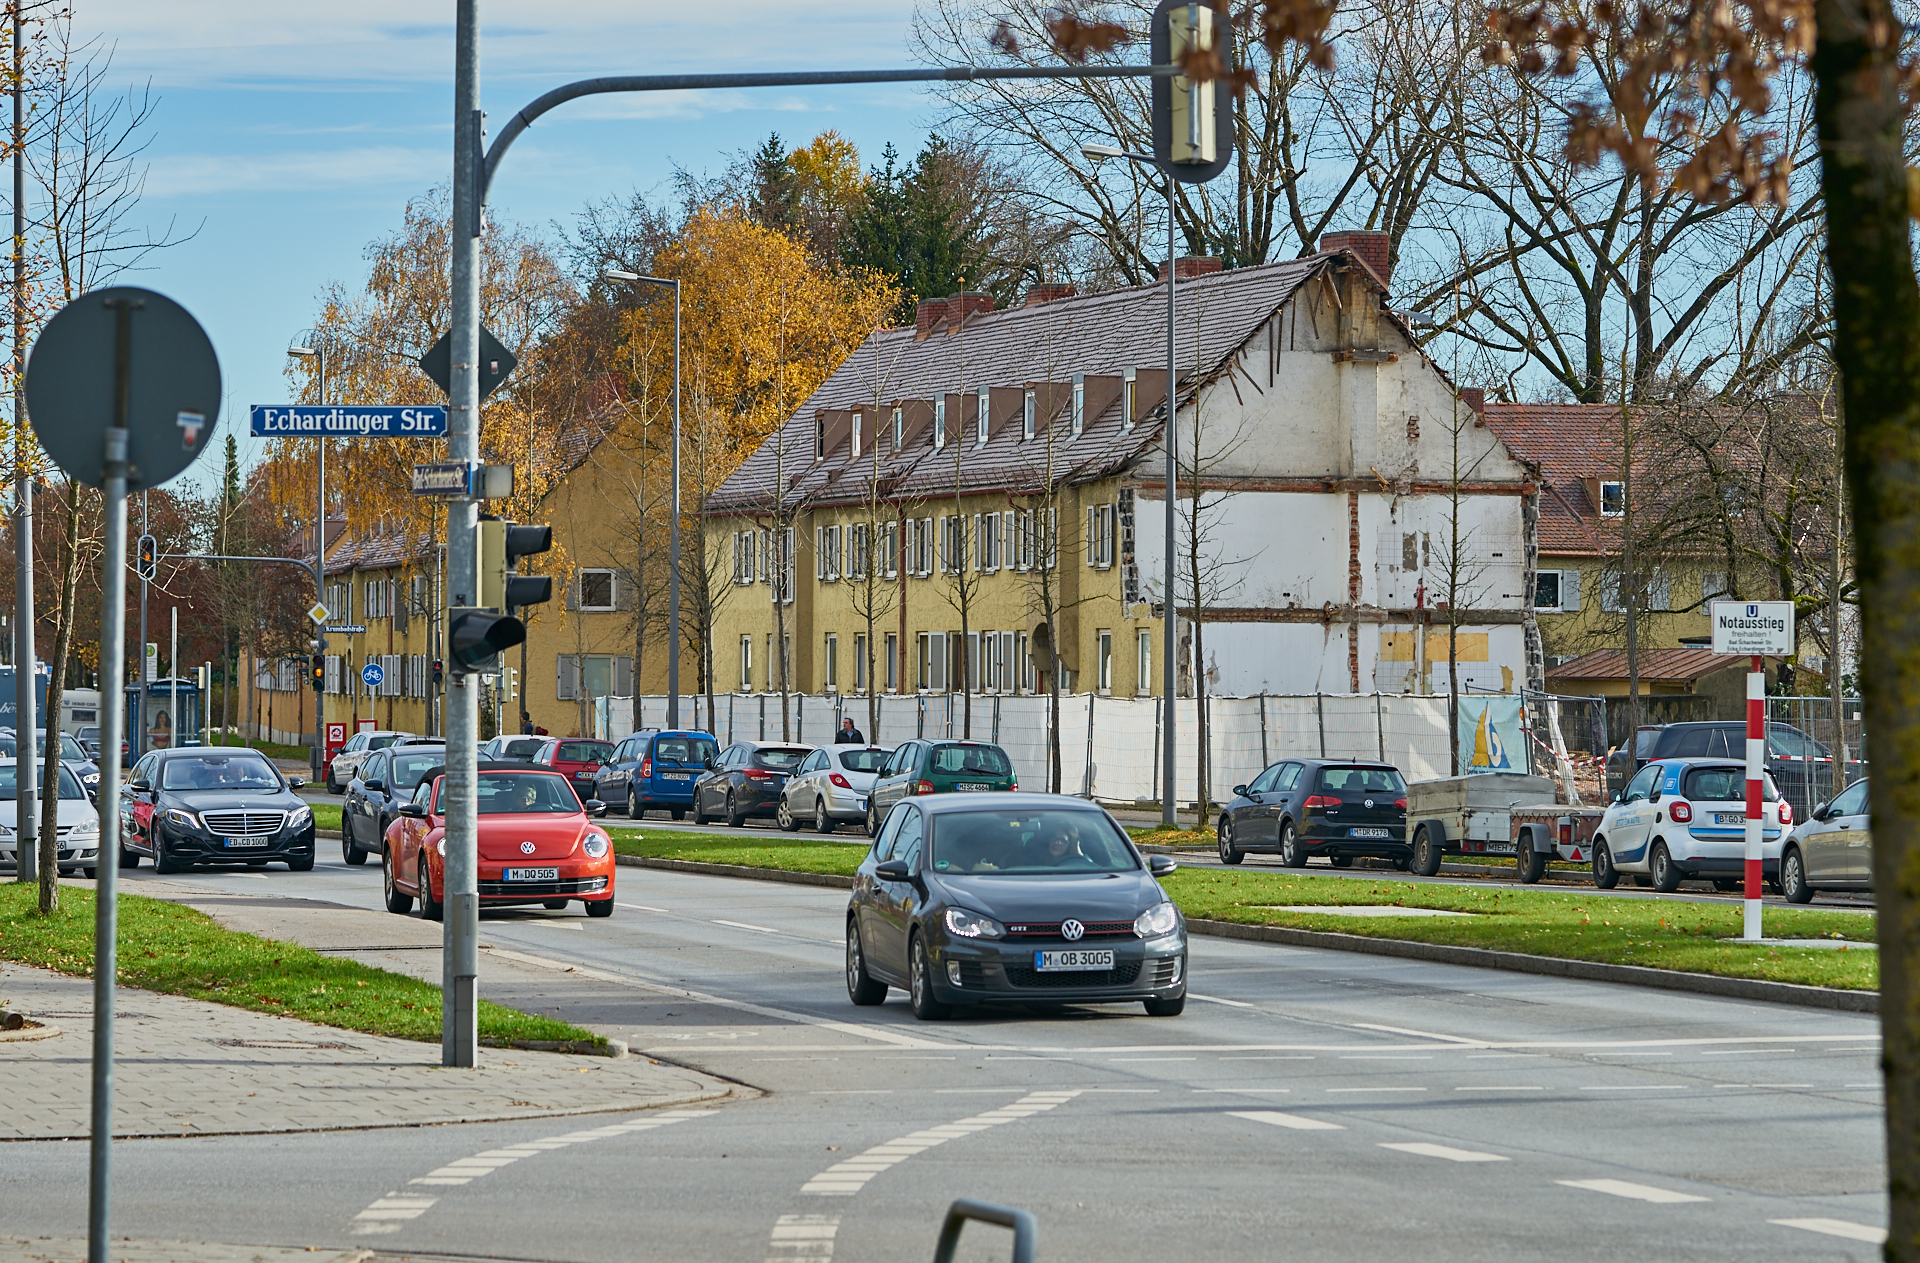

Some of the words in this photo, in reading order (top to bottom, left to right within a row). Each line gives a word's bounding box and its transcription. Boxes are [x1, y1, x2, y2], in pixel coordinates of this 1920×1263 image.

[263, 408, 393, 435] Echardinger
[401, 408, 437, 431] Str.
[1719, 616, 1784, 632] Notausstieg
[325, 625, 365, 633] Krumbadstraße
[1731, 630, 1767, 638] freihalten
[1719, 815, 1725, 823] B
[1728, 815, 1738, 824] GO
[1362, 828, 1371, 836] DR
[241, 838, 251, 846] CD
[1488, 843, 1495, 851] M
[512, 869, 519, 879] M
[524, 869, 537, 879] DQ
[538, 869, 555, 879] 505
[1043, 953, 1053, 966] M
[1060, 952, 1078, 965] OB
[1080, 951, 1112, 965] 3005
